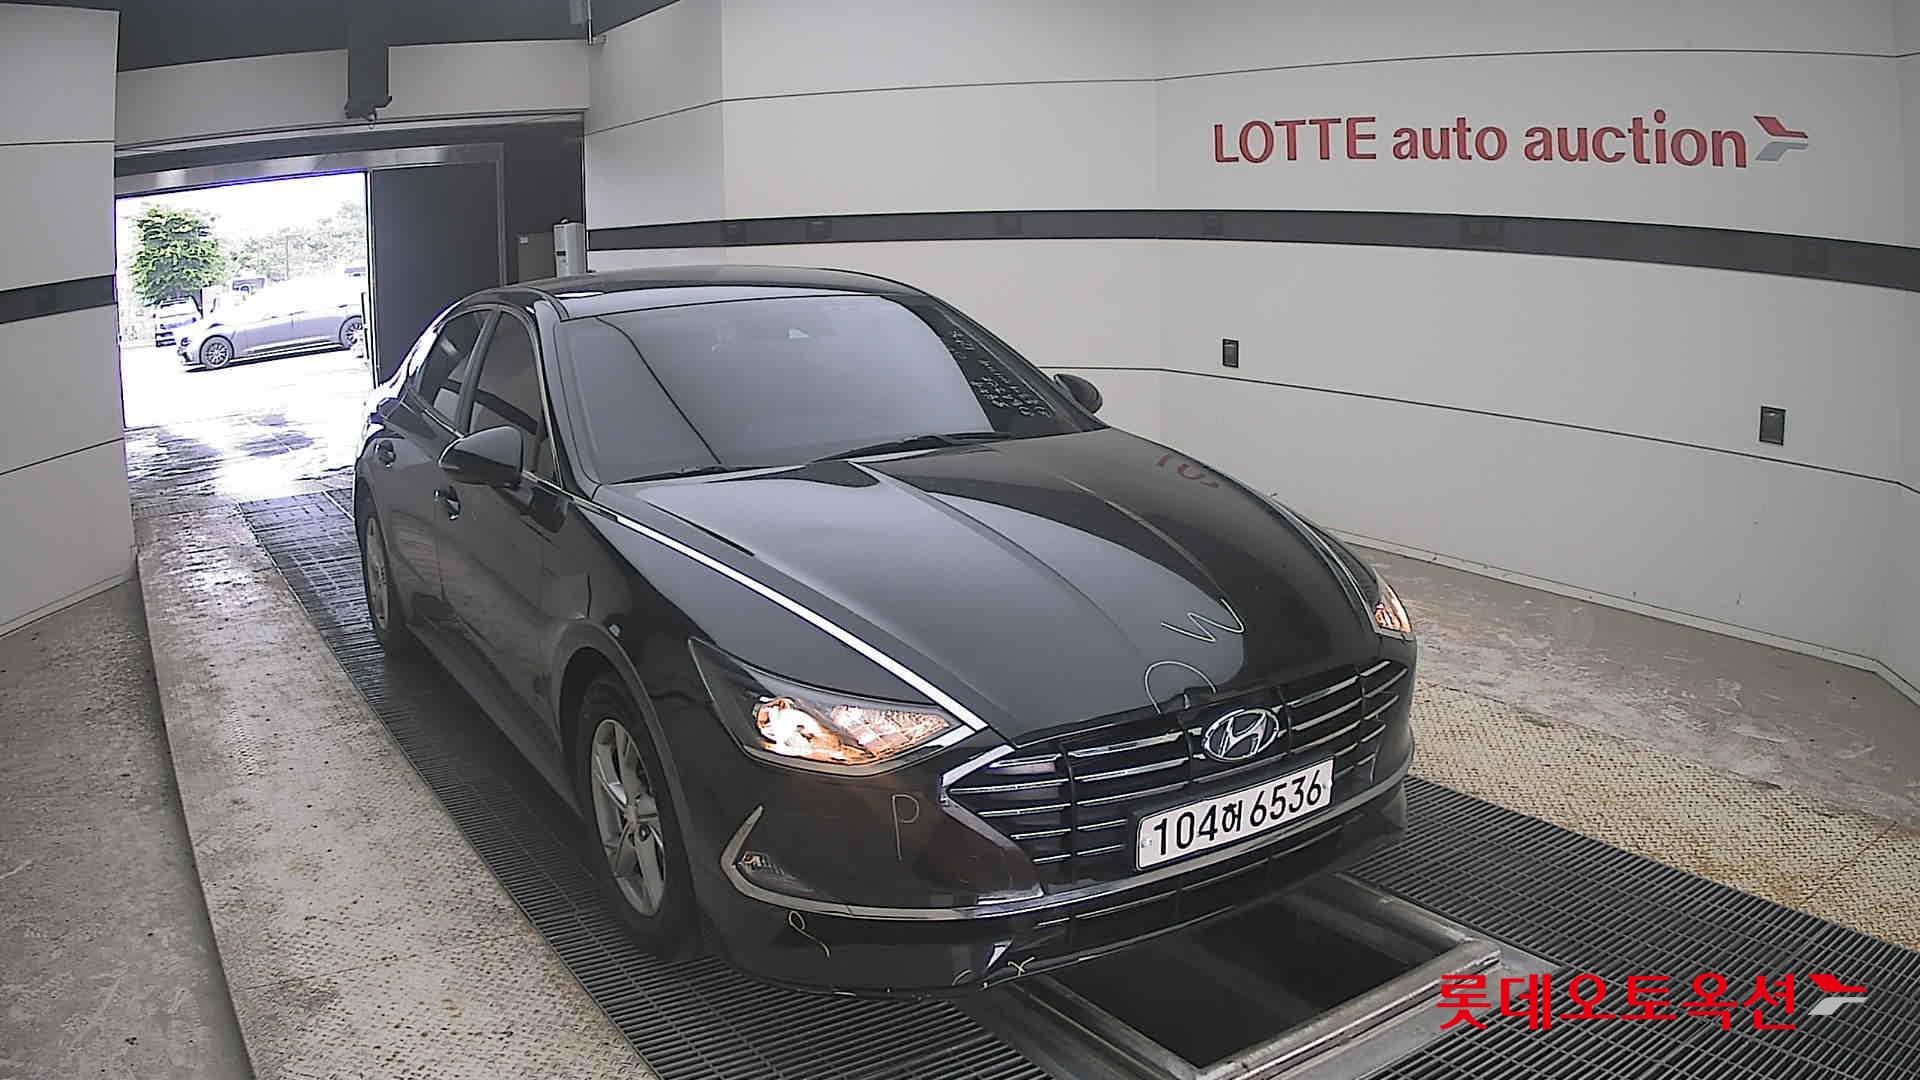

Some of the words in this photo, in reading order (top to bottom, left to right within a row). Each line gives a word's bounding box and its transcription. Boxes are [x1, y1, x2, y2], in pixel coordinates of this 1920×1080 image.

[1213, 116, 1378, 164] LOTTE
[1392, 116, 1507, 162] auto
[1523, 109, 1748, 169] auction
[891, 793, 920, 861] P
[1153, 800, 1243, 856] 104허
[1249, 769, 1323, 827] 6536
